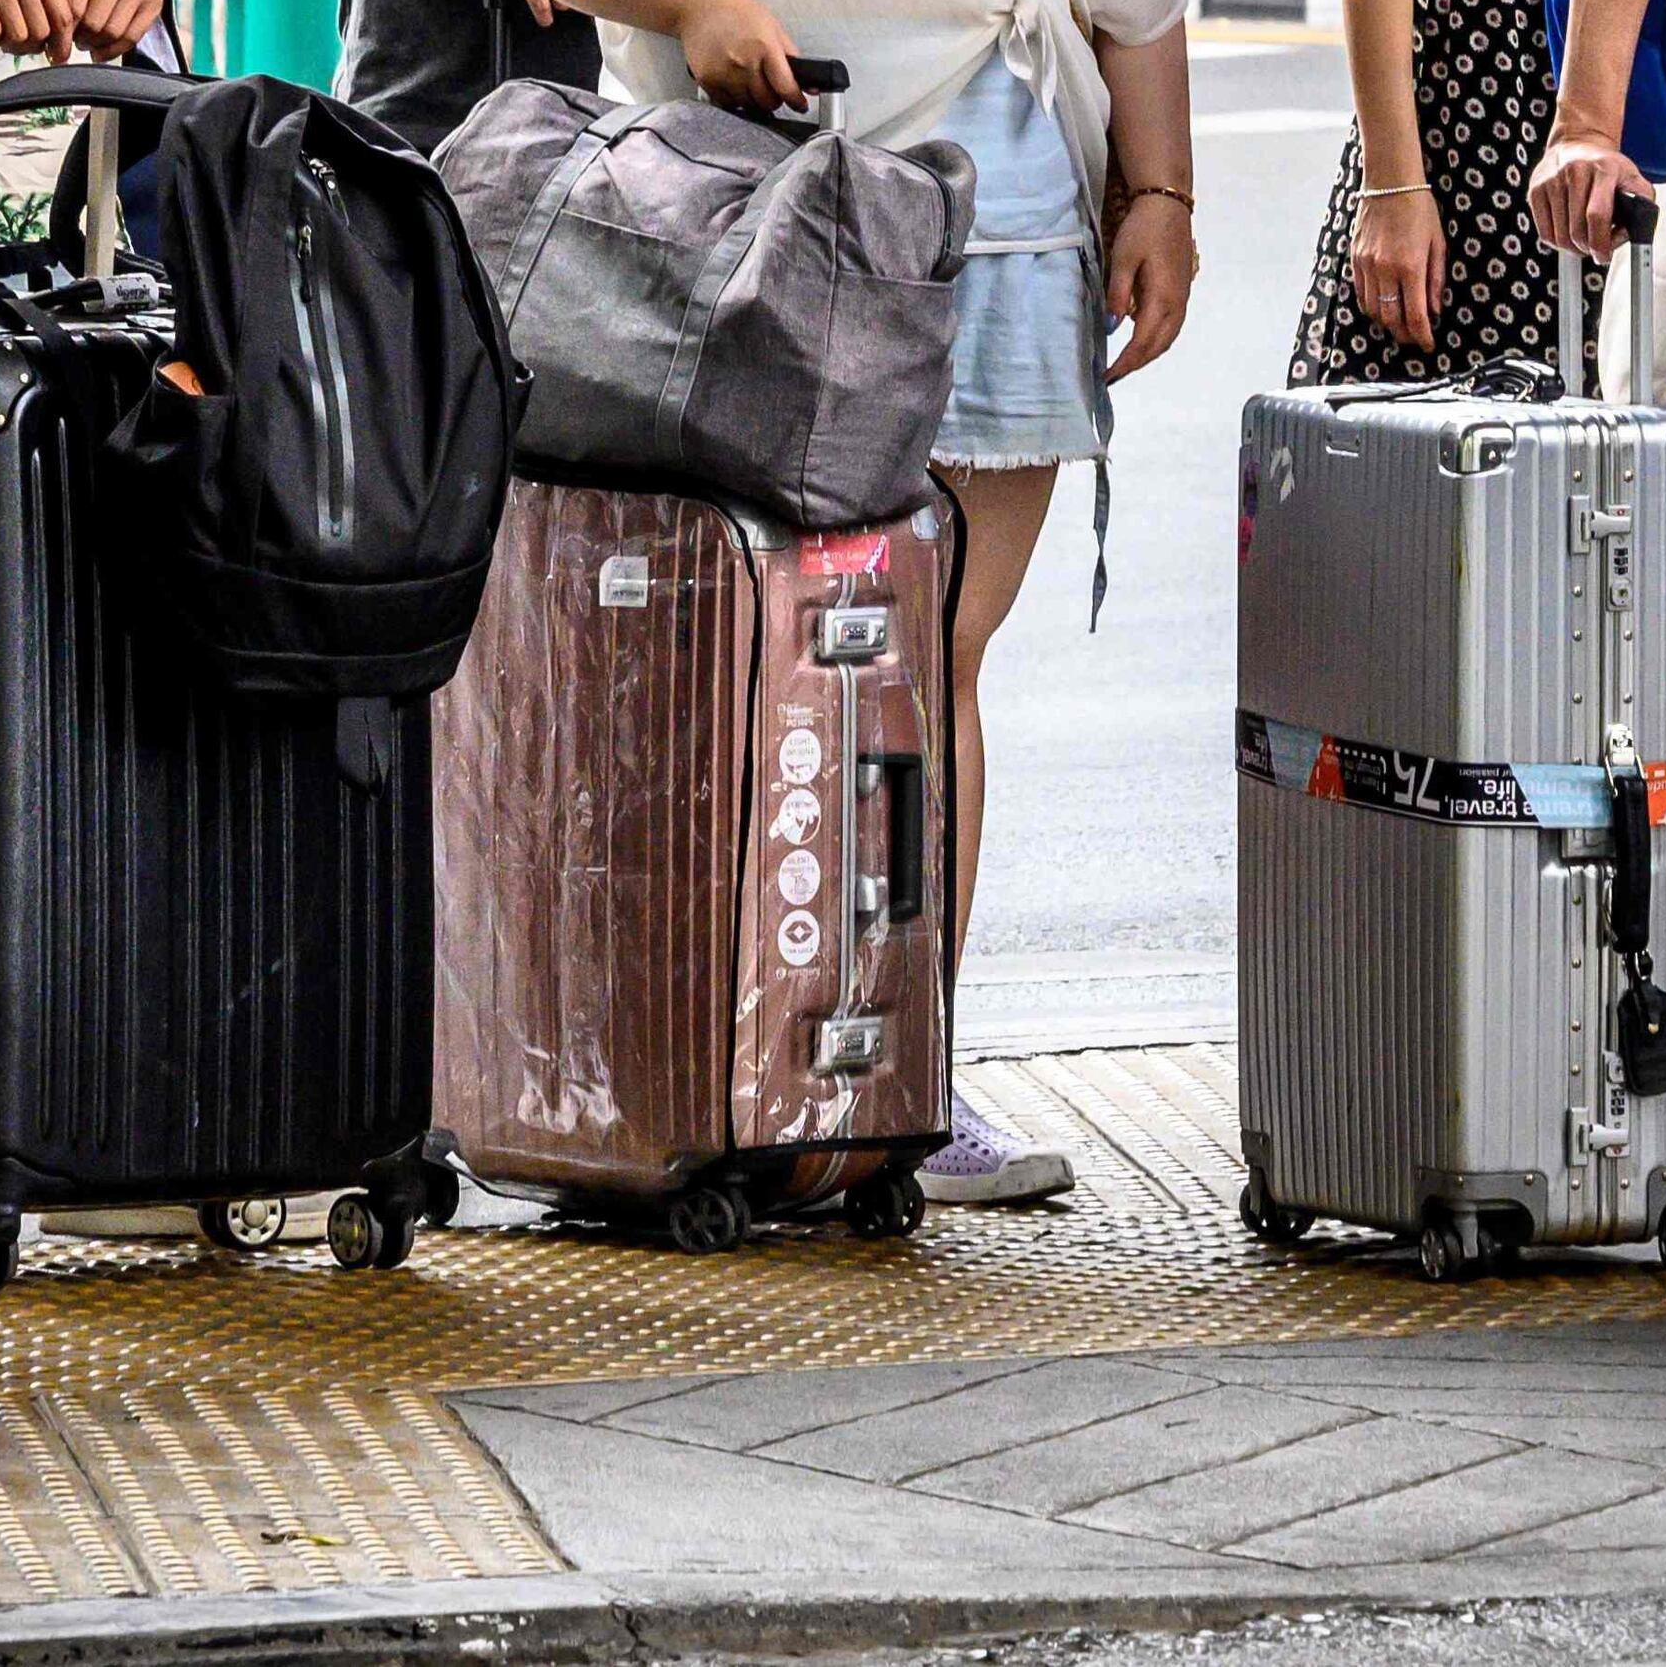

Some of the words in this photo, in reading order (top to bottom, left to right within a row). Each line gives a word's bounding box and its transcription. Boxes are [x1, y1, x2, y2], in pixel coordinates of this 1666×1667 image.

[1393, 750, 1441, 812] 75
[1478, 779, 1516, 801] life.
[1445, 795, 1518, 818] travel,
